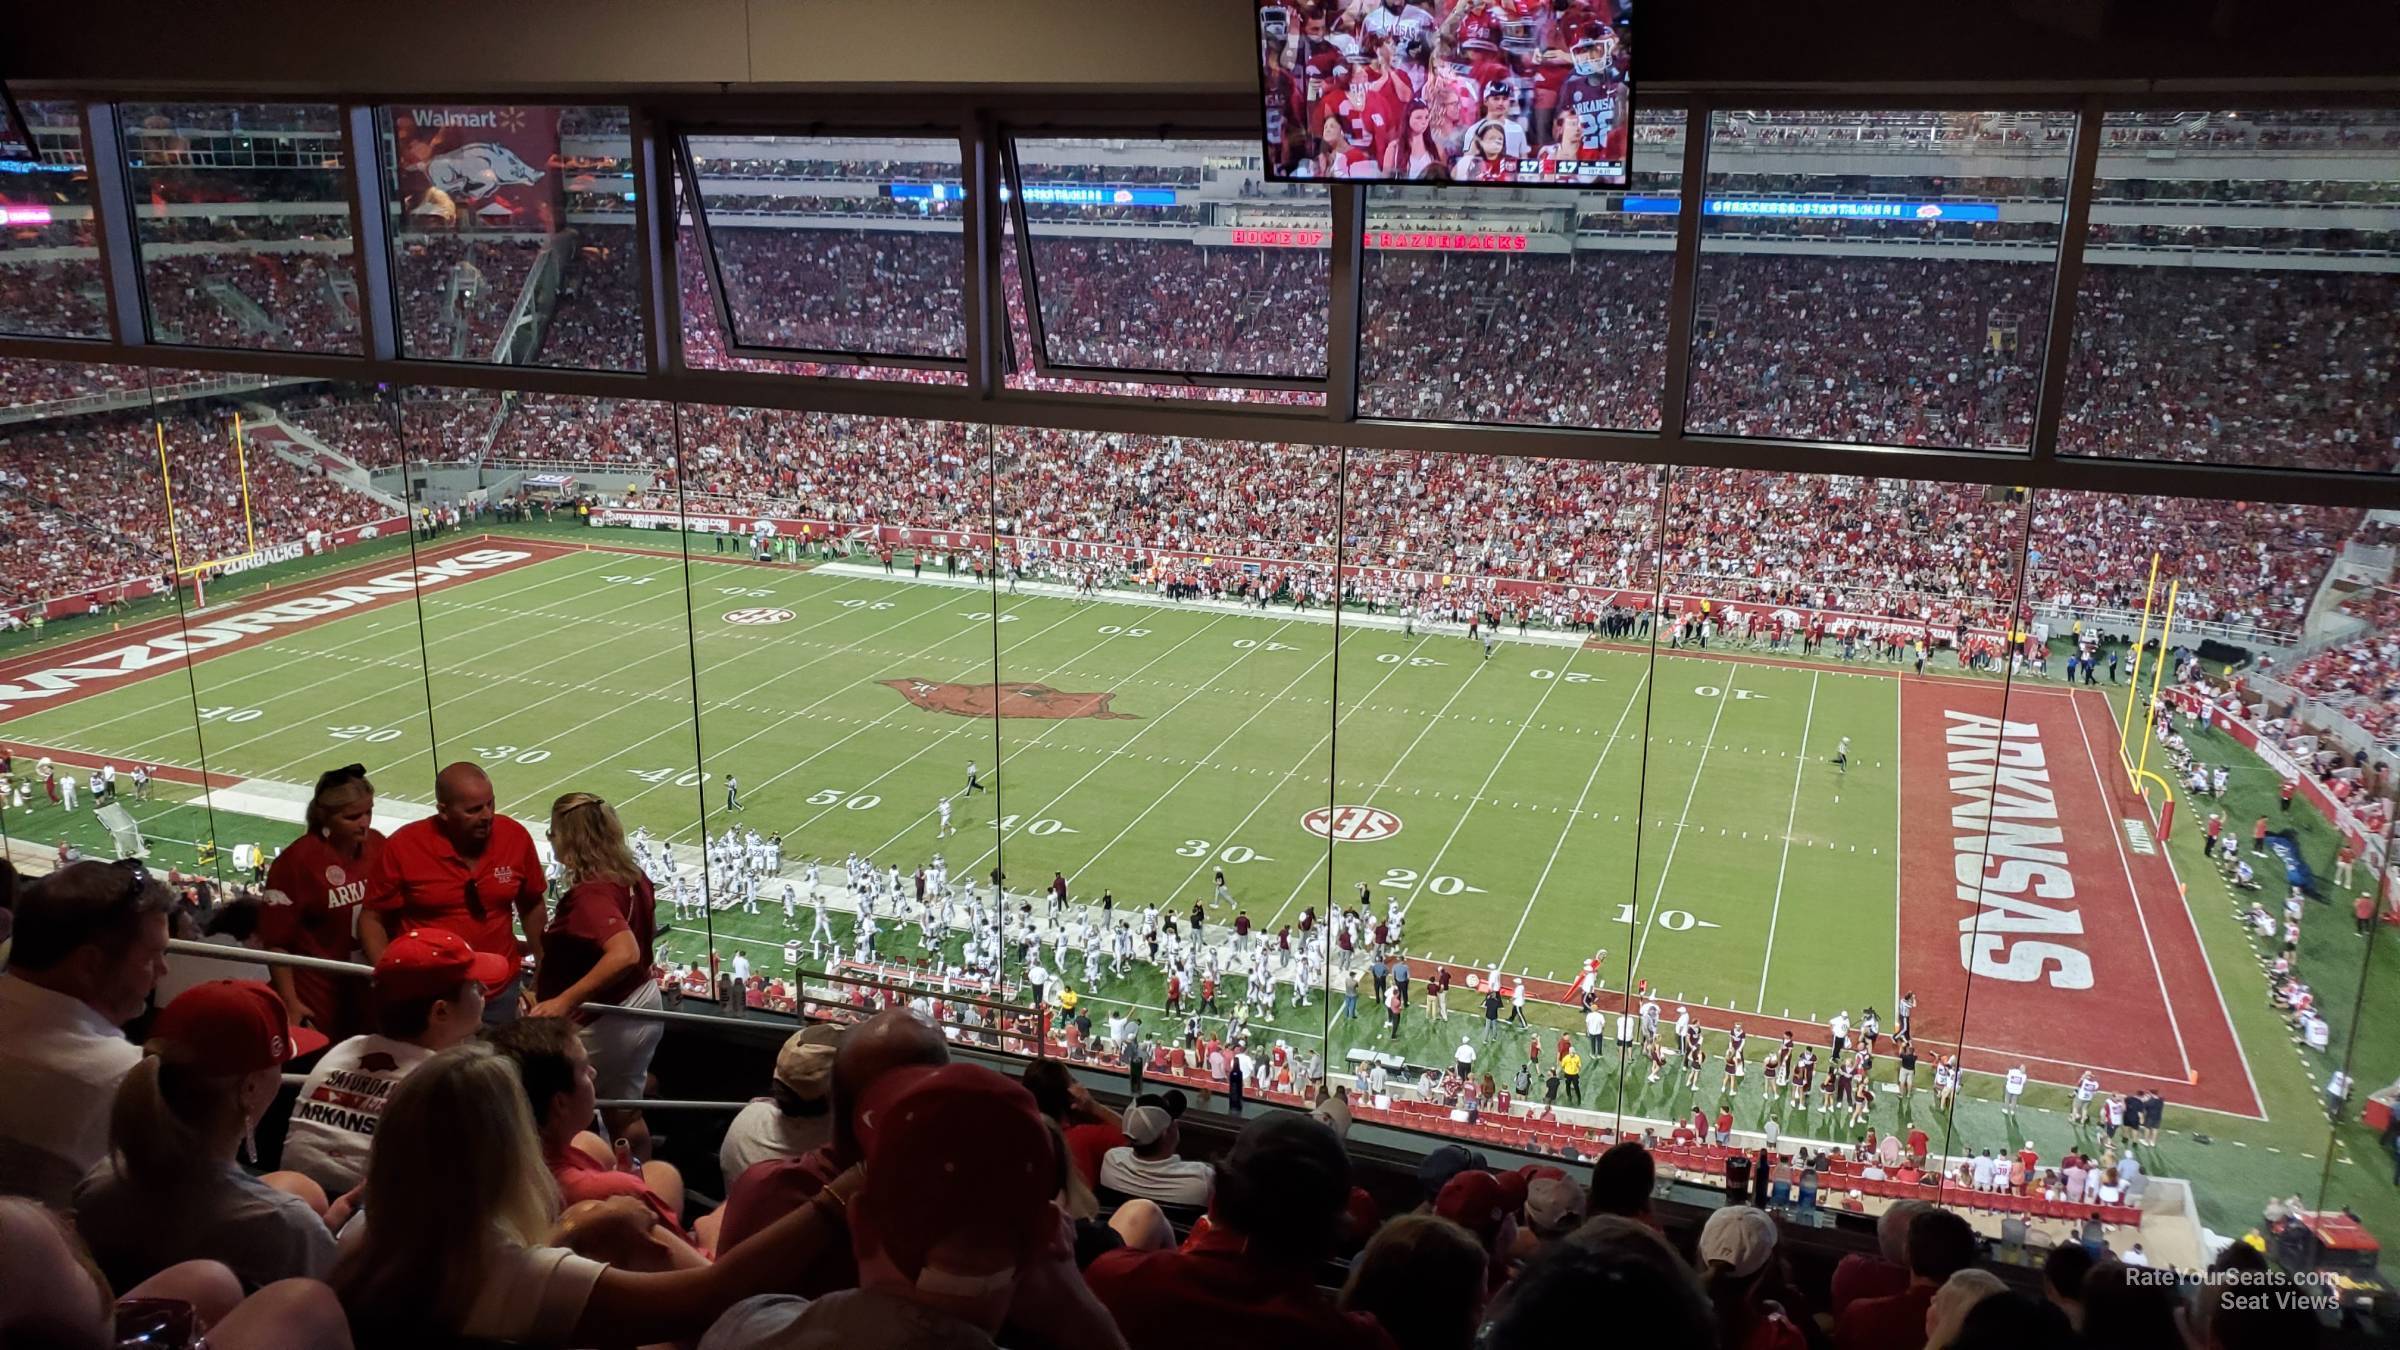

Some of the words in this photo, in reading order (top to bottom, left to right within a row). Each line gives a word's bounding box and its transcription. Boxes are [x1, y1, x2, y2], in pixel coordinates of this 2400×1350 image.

[412, 109, 497, 128] Walmart
[1519, 160, 1539, 174] 17
[1558, 161, 1578, 175] 17
[1231, 230, 1293, 245] HOME
[1297, 232, 1324, 246] OF
[1379, 232, 1527, 250] RAZORBACKS
[198, 706, 264, 724] 10
[329, 724, 403, 743] 20
[479, 744, 552, 764] 30
[638, 767, 712, 787] 40
[805, 789, 882, 810] 50
[986, 814, 1063, 836] 40
[1175, 839, 1256, 864] 30
[1943, 709, 2095, 990] ARKANSAS
[1378, 868, 1466, 896] 20
[328, 879, 367, 909] ARKA
[1611, 903, 1696, 931] 10
